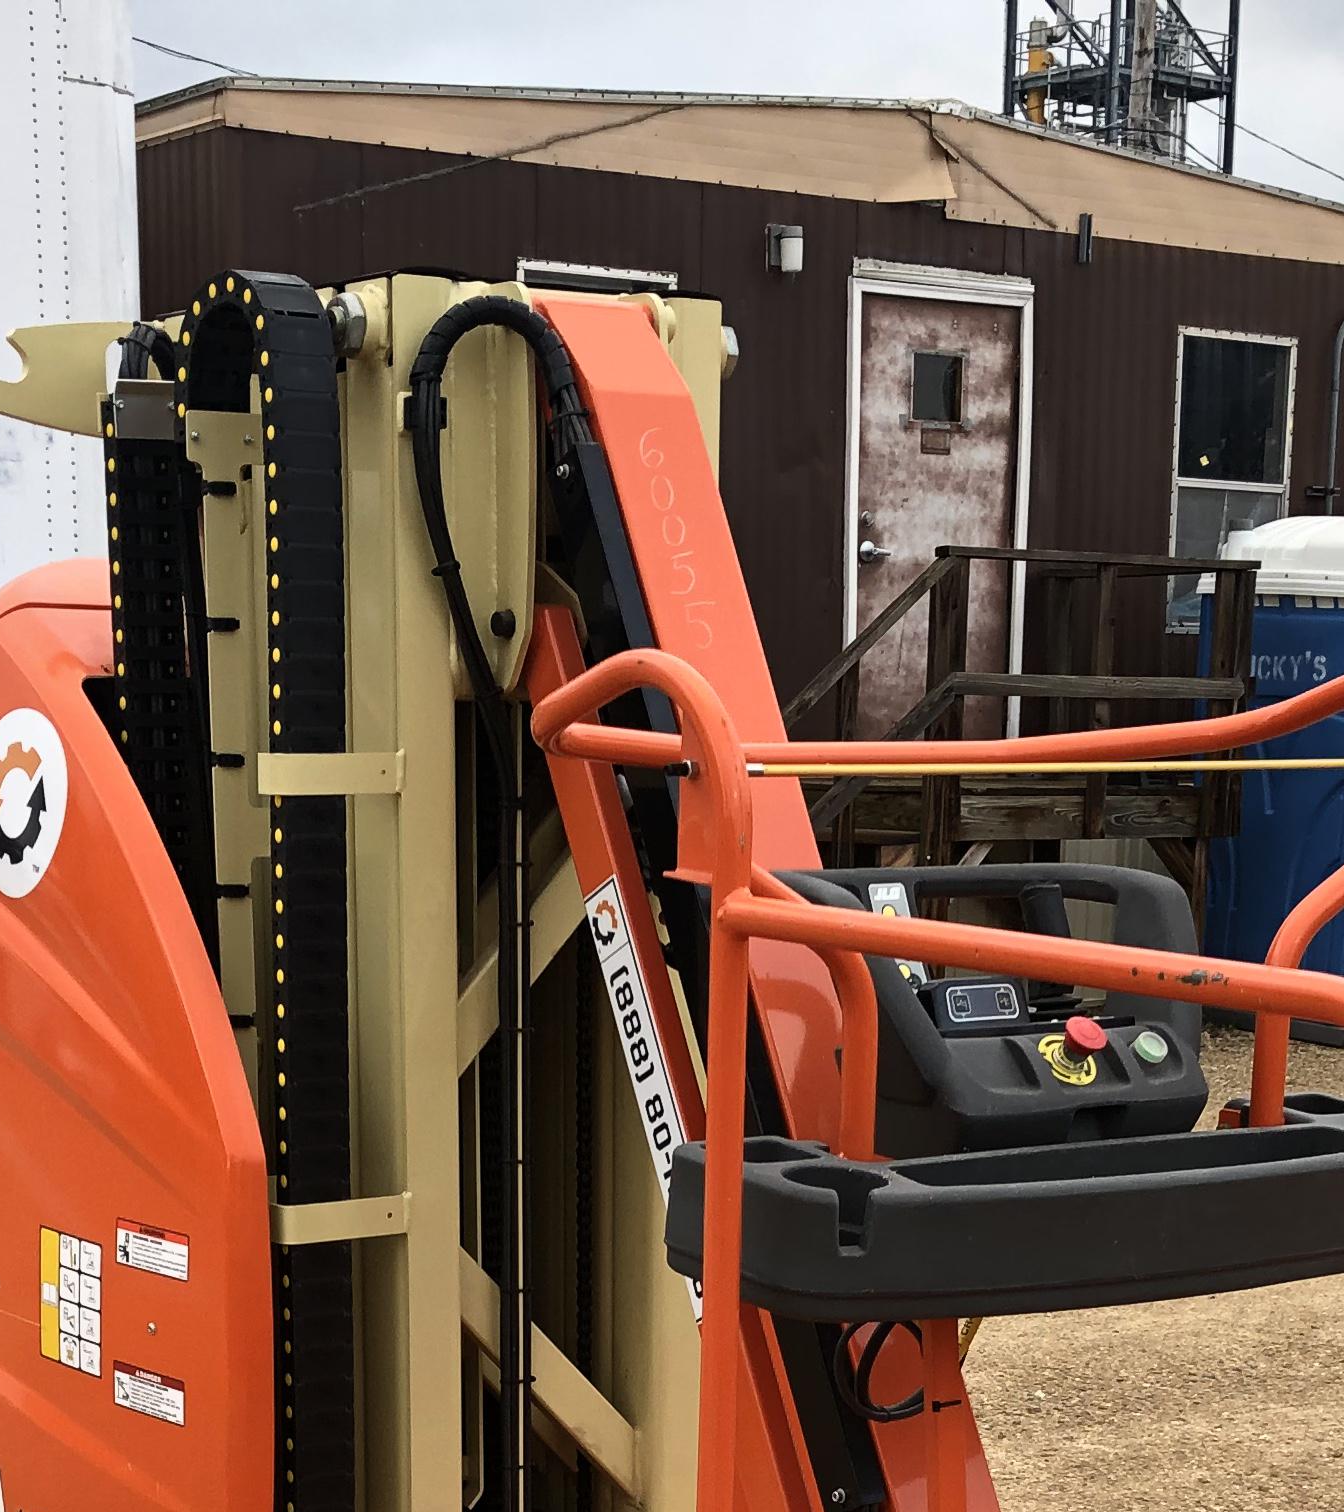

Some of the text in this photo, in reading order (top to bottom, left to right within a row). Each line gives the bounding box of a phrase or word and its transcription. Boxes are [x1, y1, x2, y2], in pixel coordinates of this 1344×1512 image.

[639, 427, 716, 650] 60055
[1249, 651, 1327, 681] CKY'S
[609, 964, 655, 1084] (888)
